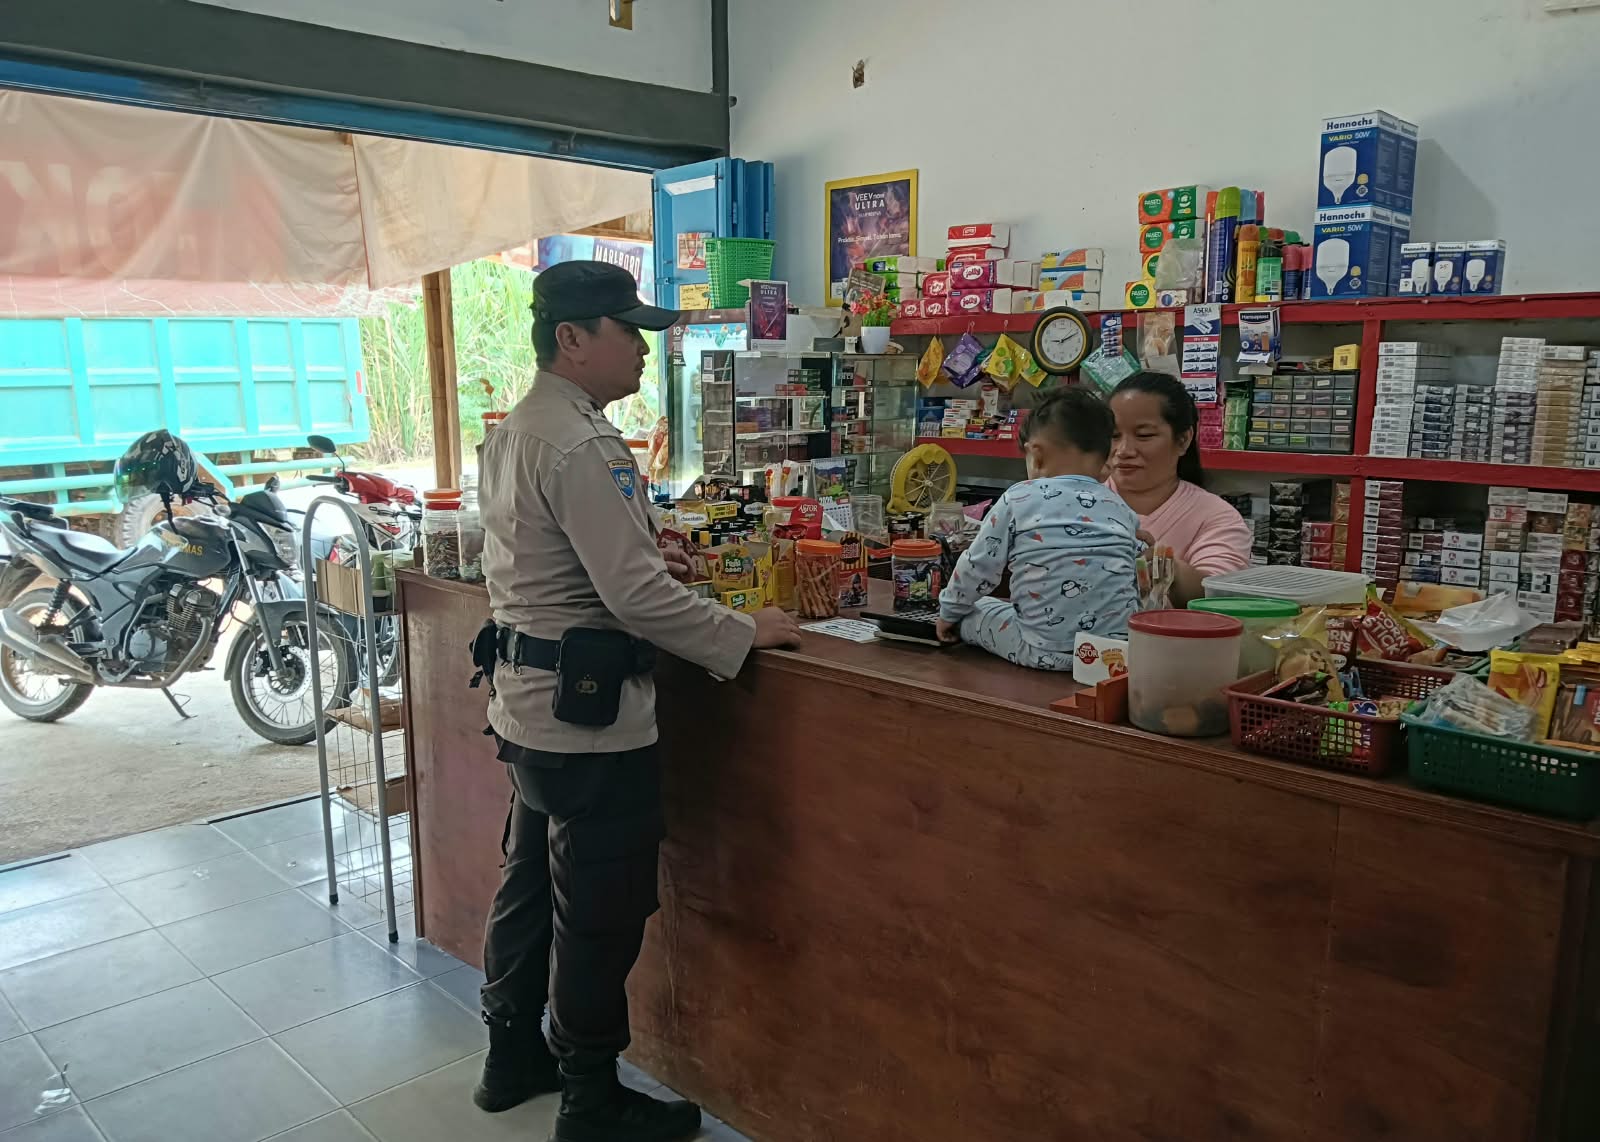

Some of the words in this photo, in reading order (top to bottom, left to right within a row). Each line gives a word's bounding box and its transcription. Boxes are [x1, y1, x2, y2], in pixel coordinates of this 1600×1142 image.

[1326, 117, 1373, 131] Hannochs
[1328, 134, 1353, 142] VARIO
[1354, 131, 1371, 139] 50W
[855, 192, 874, 202] VEEV
[855, 199, 885, 210] ULTRA
[1319, 211, 1366, 222] Hannochs
[594, 244, 640, 281] MARLBORO
[964, 267, 981, 278] jolly
[962, 296, 978, 307] jolly
[799, 504, 818, 513] ASTOR
[1377, 609, 1409, 647] CORN
[1361, 616, 1399, 655] STICK
[1075, 648, 1099, 659] ASTOR
